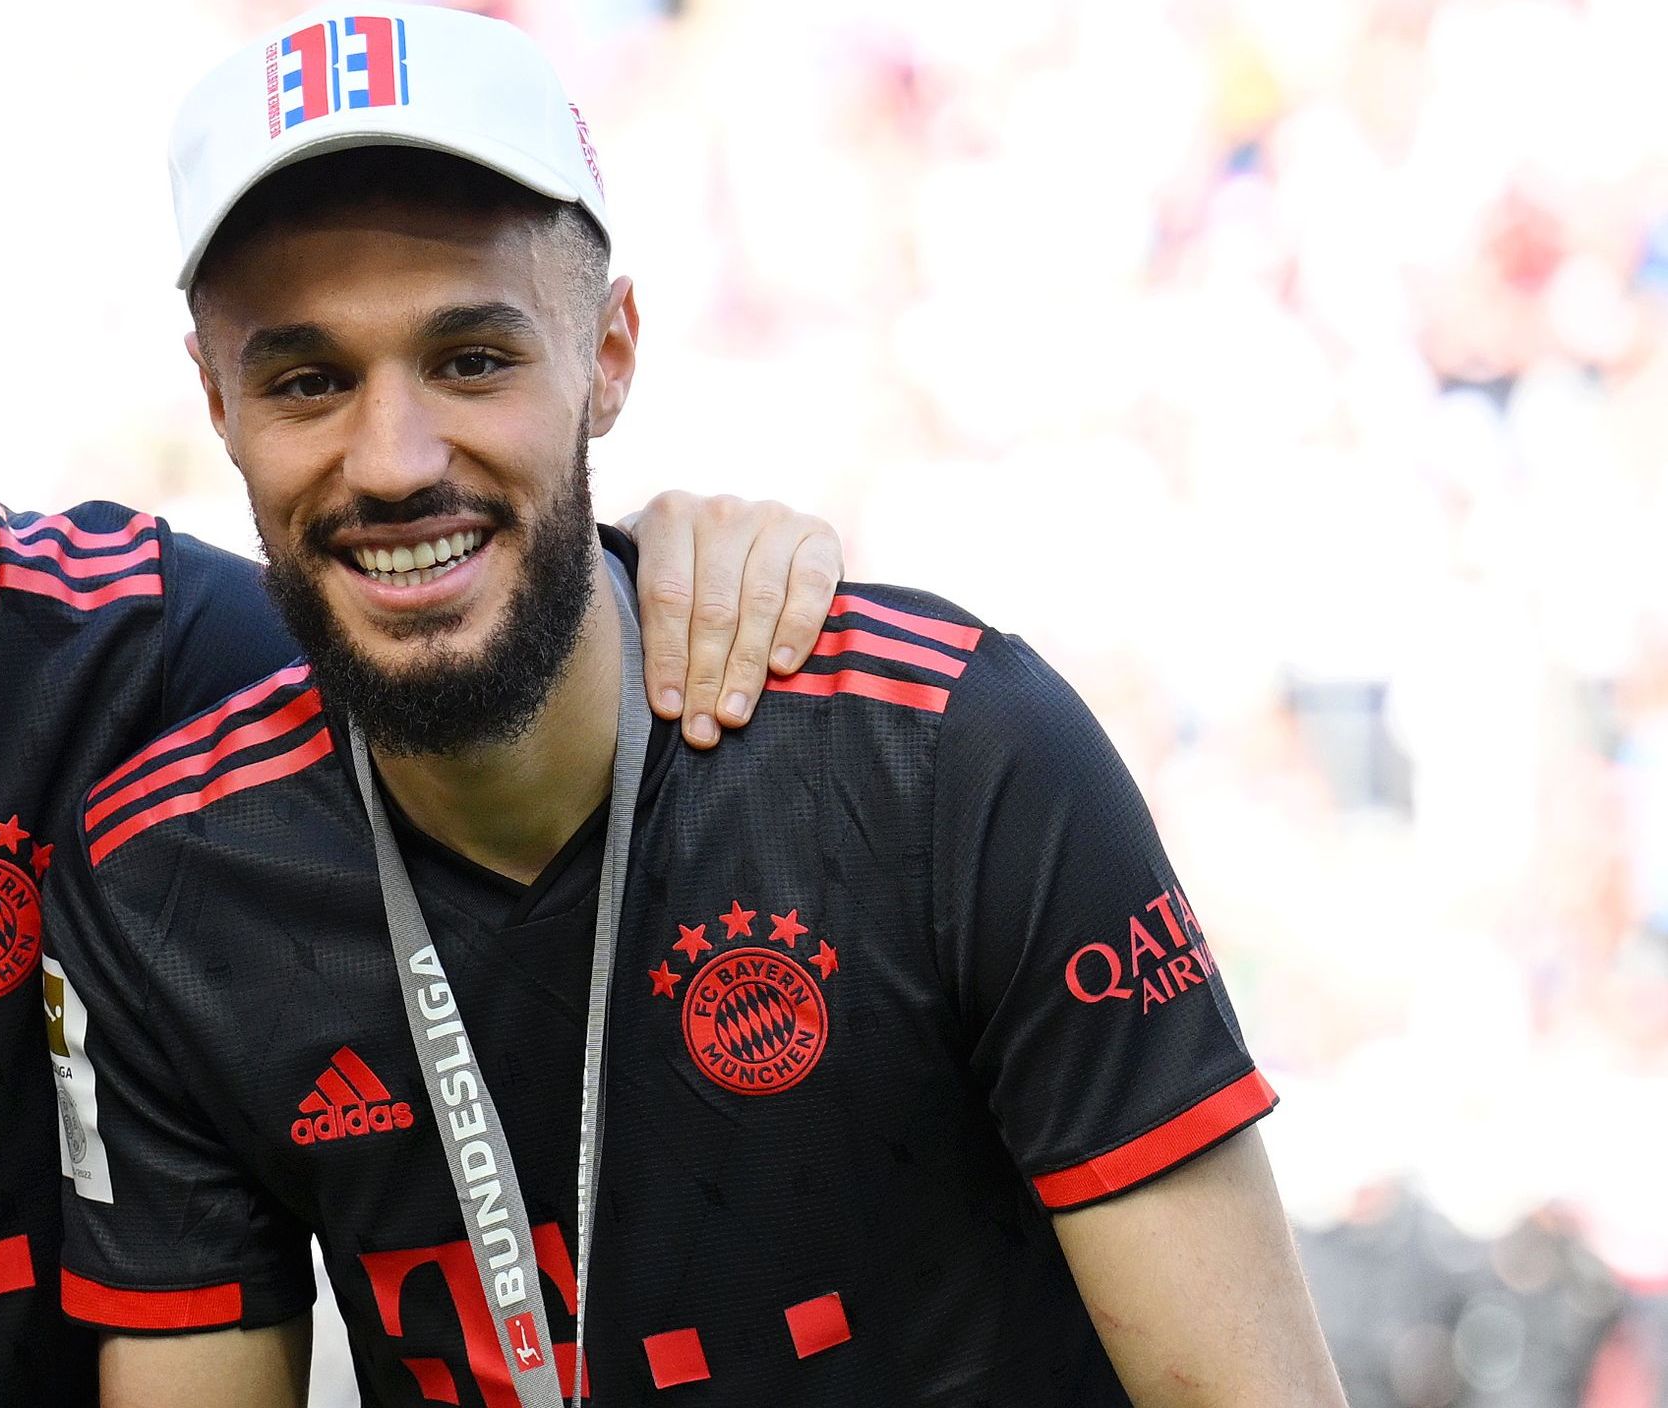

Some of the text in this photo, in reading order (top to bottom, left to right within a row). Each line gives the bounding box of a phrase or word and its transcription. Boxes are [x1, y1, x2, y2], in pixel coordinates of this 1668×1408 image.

[1065, 884, 1201, 1004] QATA
[1143, 941, 1219, 1016] AIRW
[694, 959, 809, 1018] FC BAYERN
[290, 1098, 414, 1146] adidas
[408, 943, 526, 1309] BUNDESLIGA
